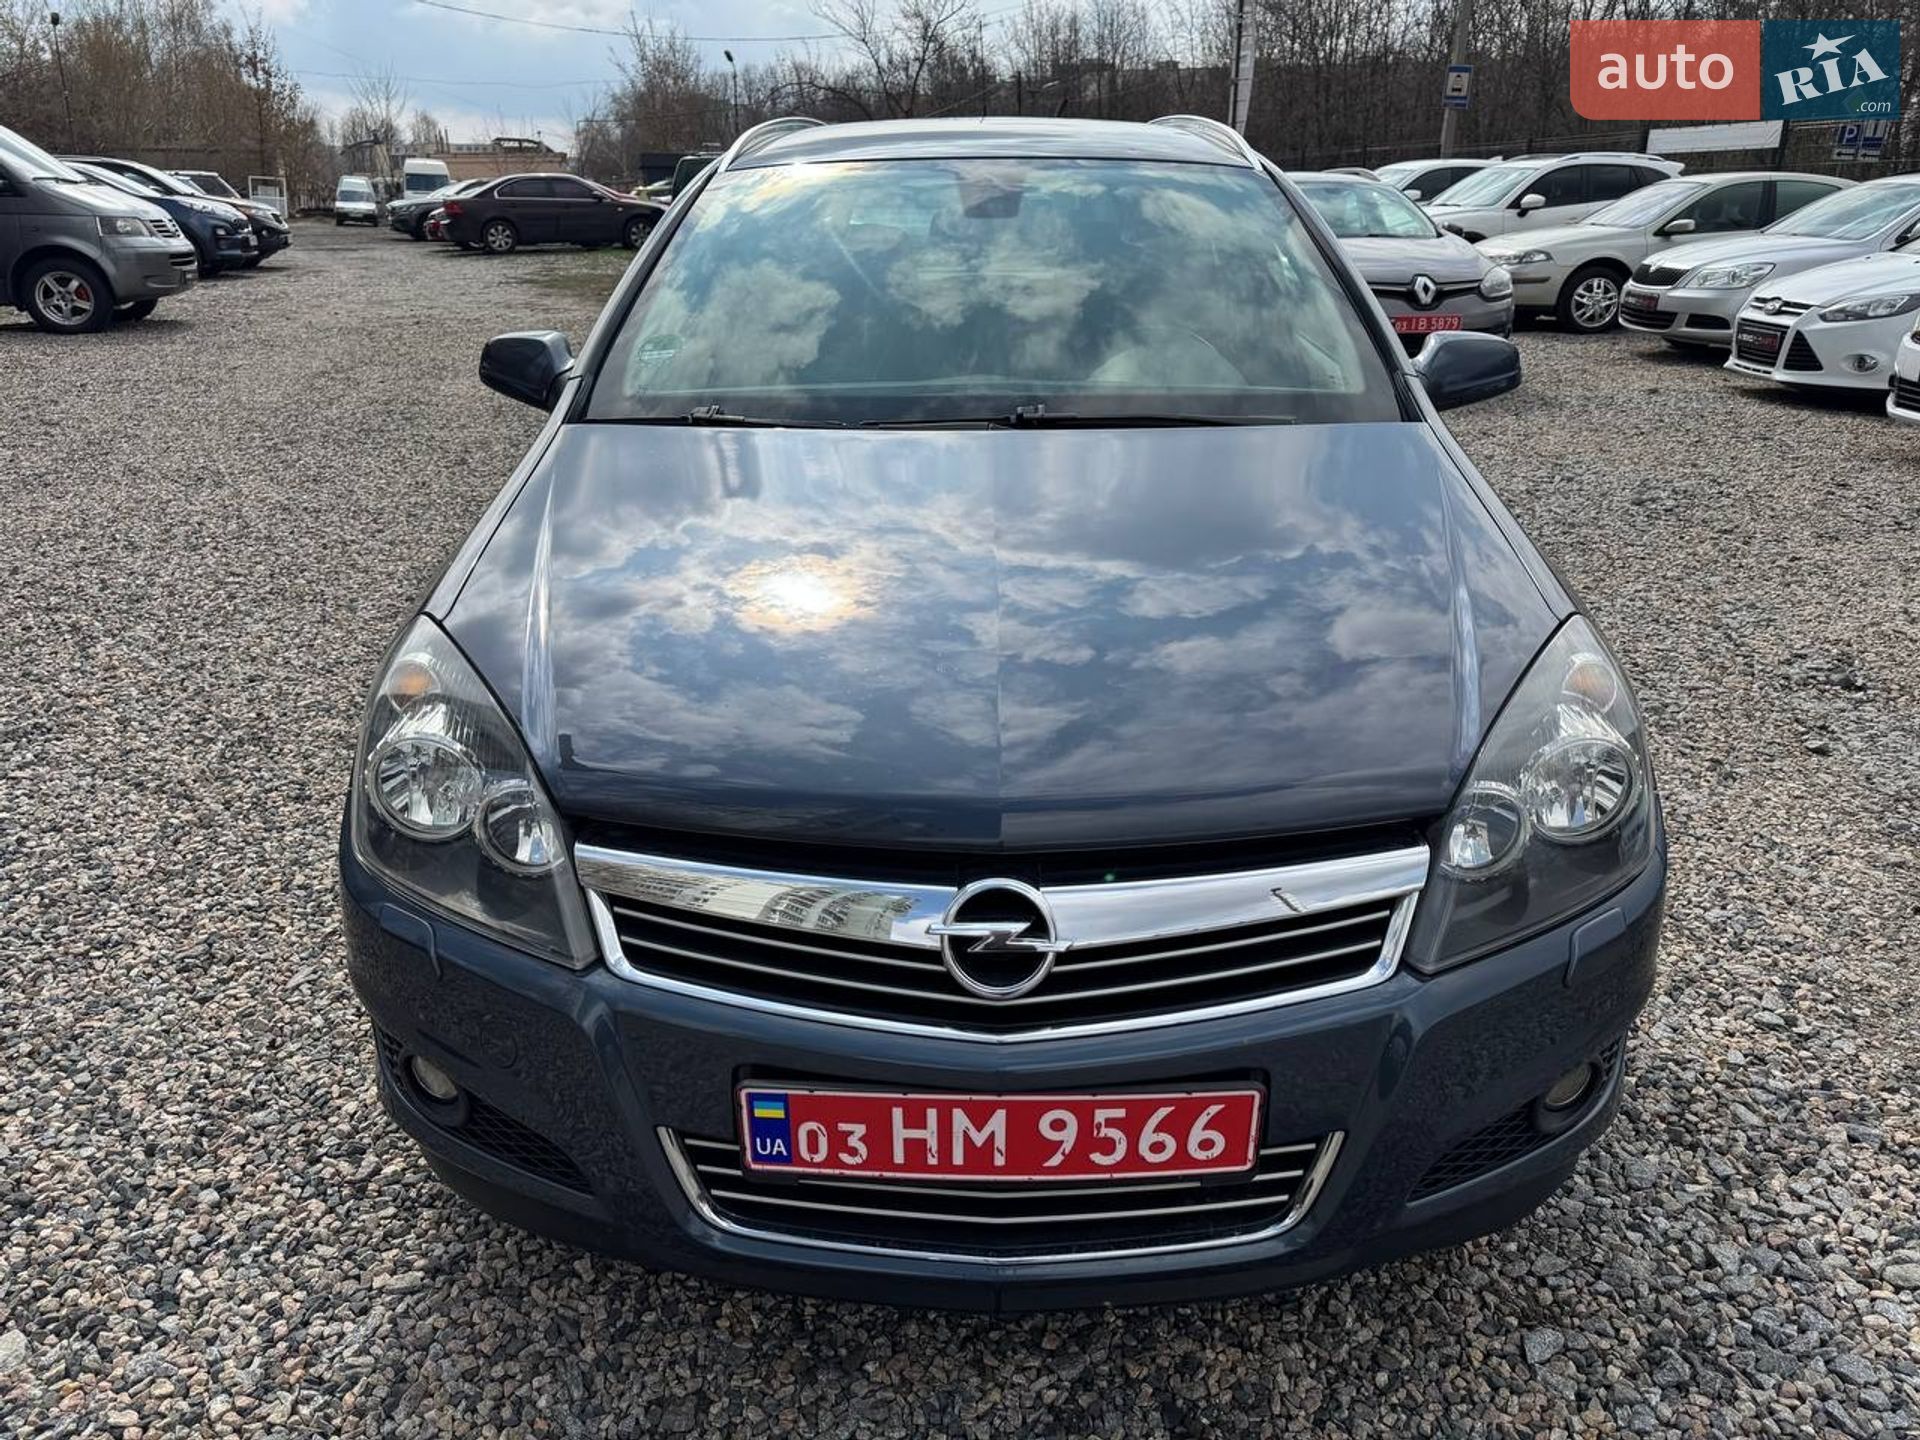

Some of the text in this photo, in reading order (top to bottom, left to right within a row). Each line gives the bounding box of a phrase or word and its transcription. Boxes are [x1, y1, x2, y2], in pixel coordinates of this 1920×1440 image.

[1842, 125, 1858, 144] P
[797, 1104, 1226, 1167] 03 HM 9566
[755, 1137, 787, 1156] UA
